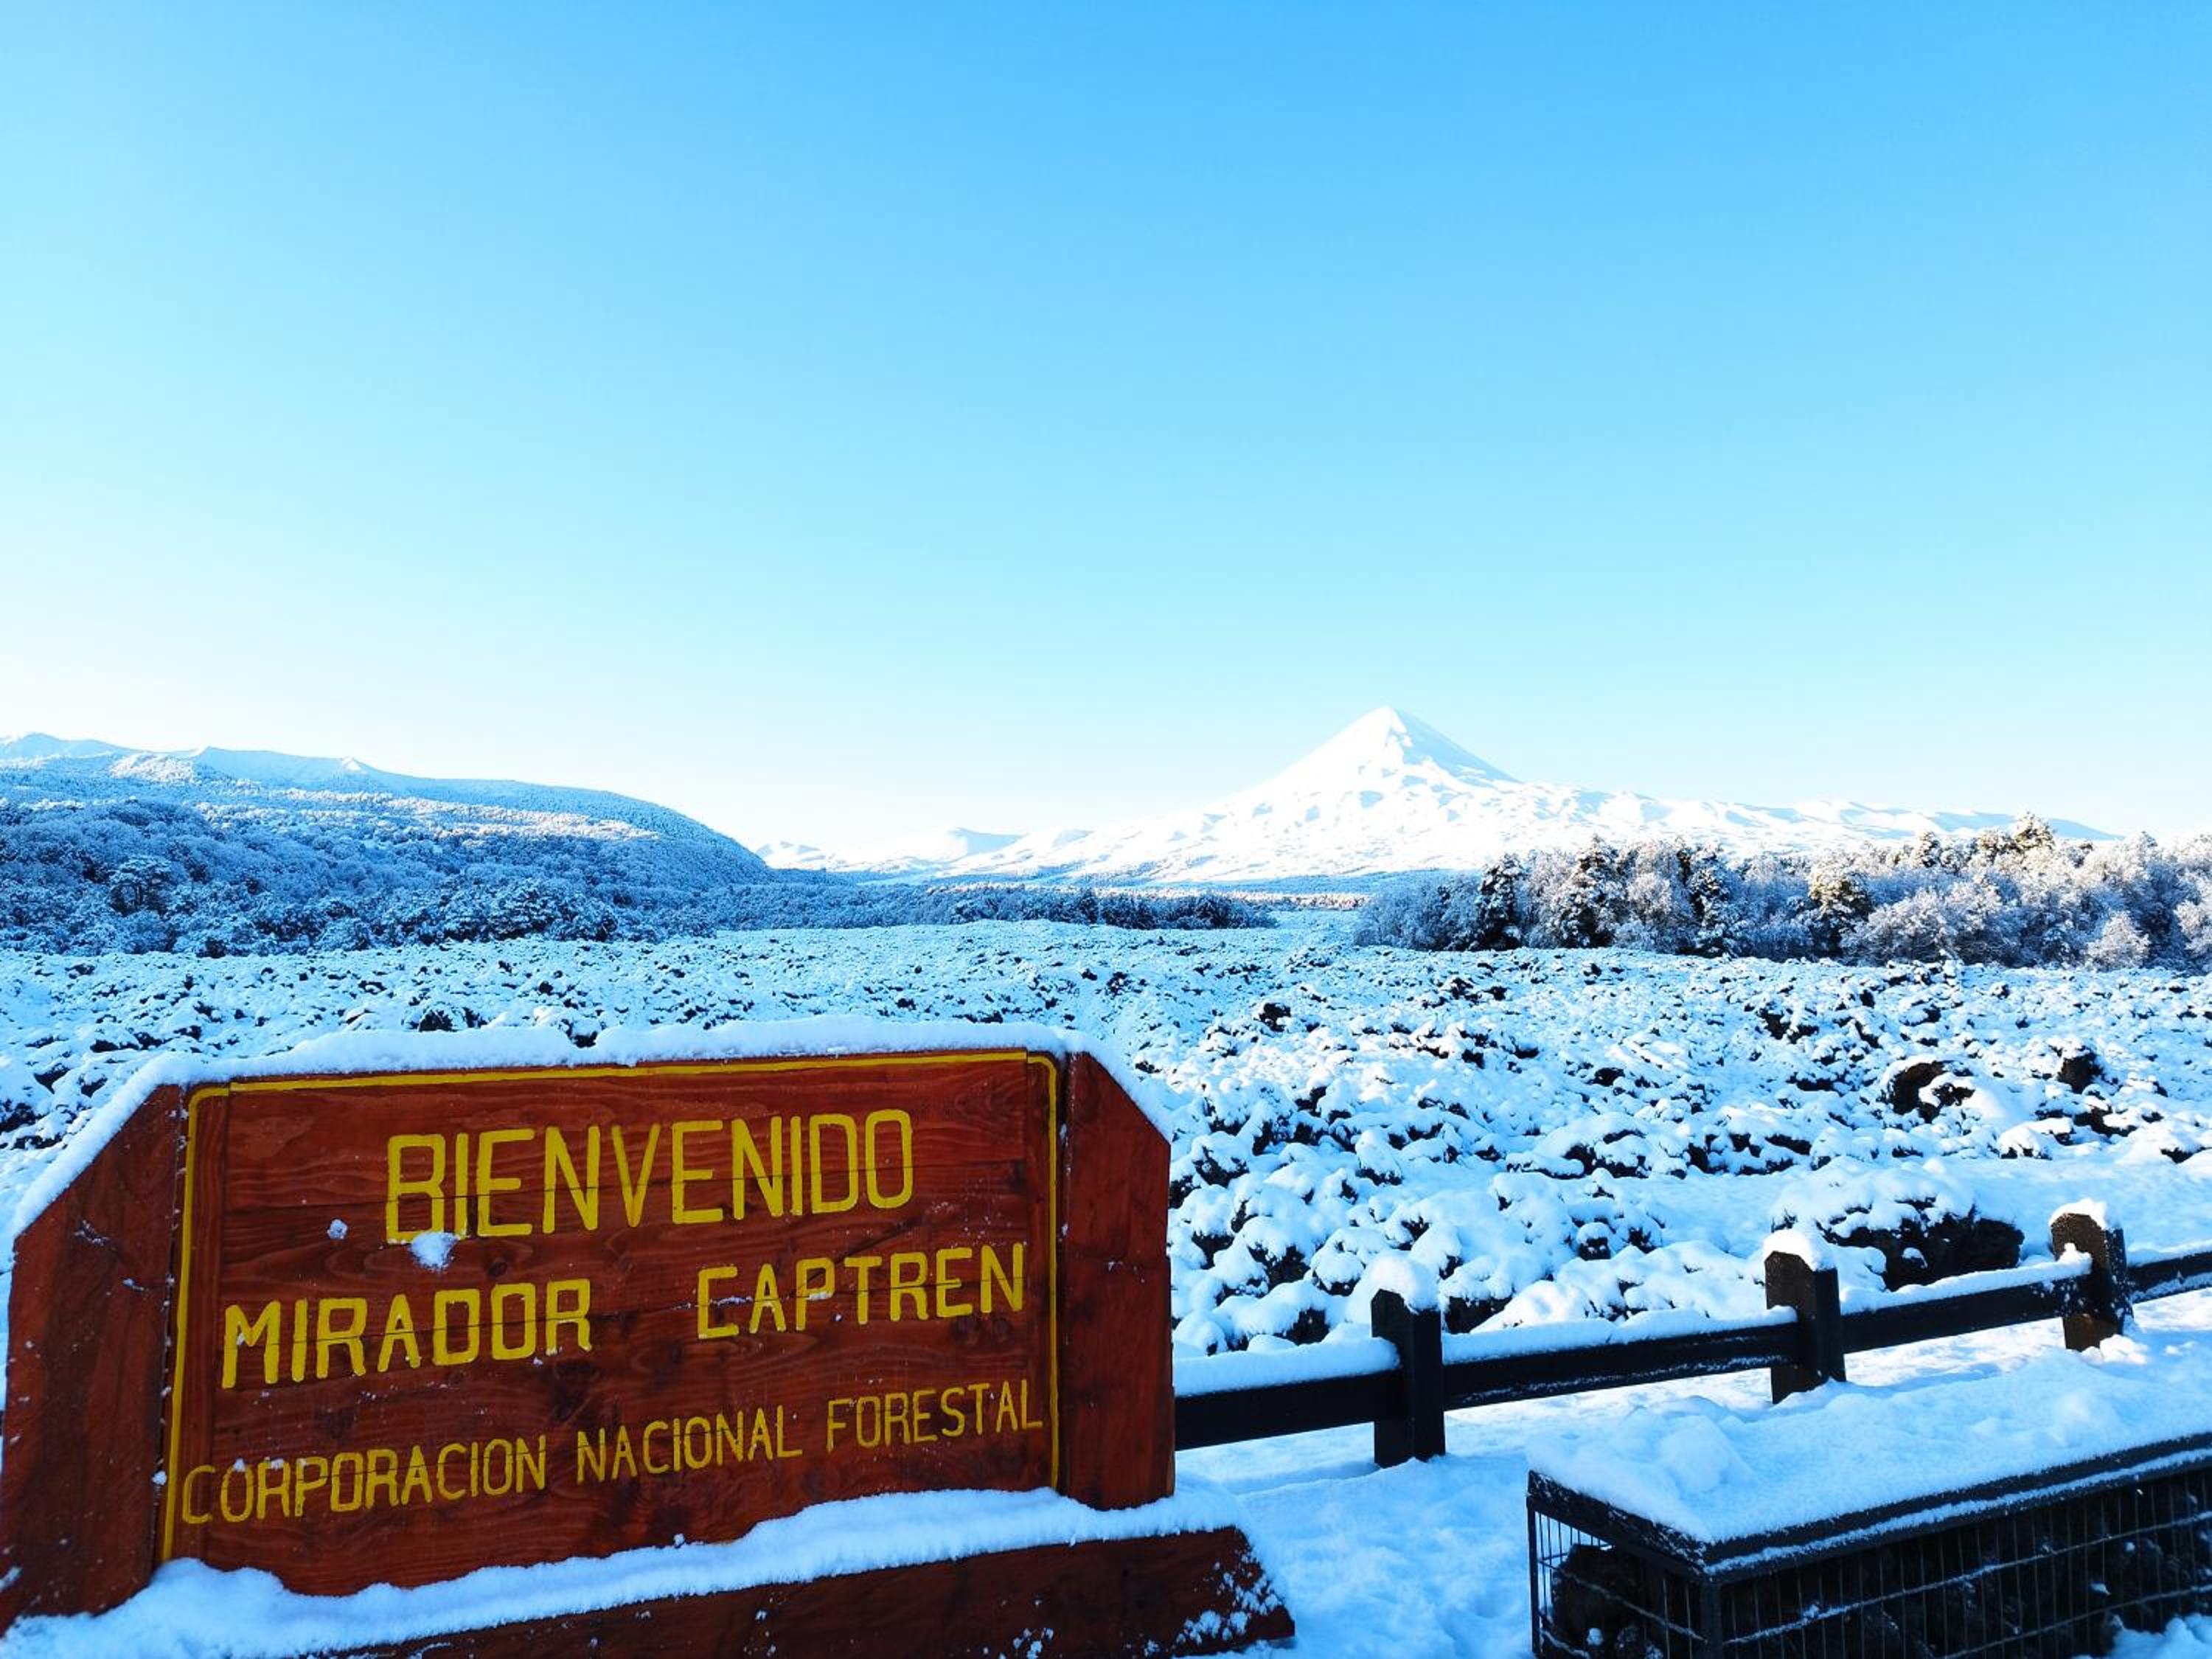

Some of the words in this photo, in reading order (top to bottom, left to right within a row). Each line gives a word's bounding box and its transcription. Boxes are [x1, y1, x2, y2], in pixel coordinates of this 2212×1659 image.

[386, 1109, 914, 1245] BIENVENIDO
[222, 1279, 592, 1389] MIRADOR
[697, 1242, 1025, 1340] CAPTREN
[182, 1434, 546, 1525] CORPORACION
[576, 1404, 803, 1484] NACIONAL
[826, 1378, 1043, 1453] FORESTAL
